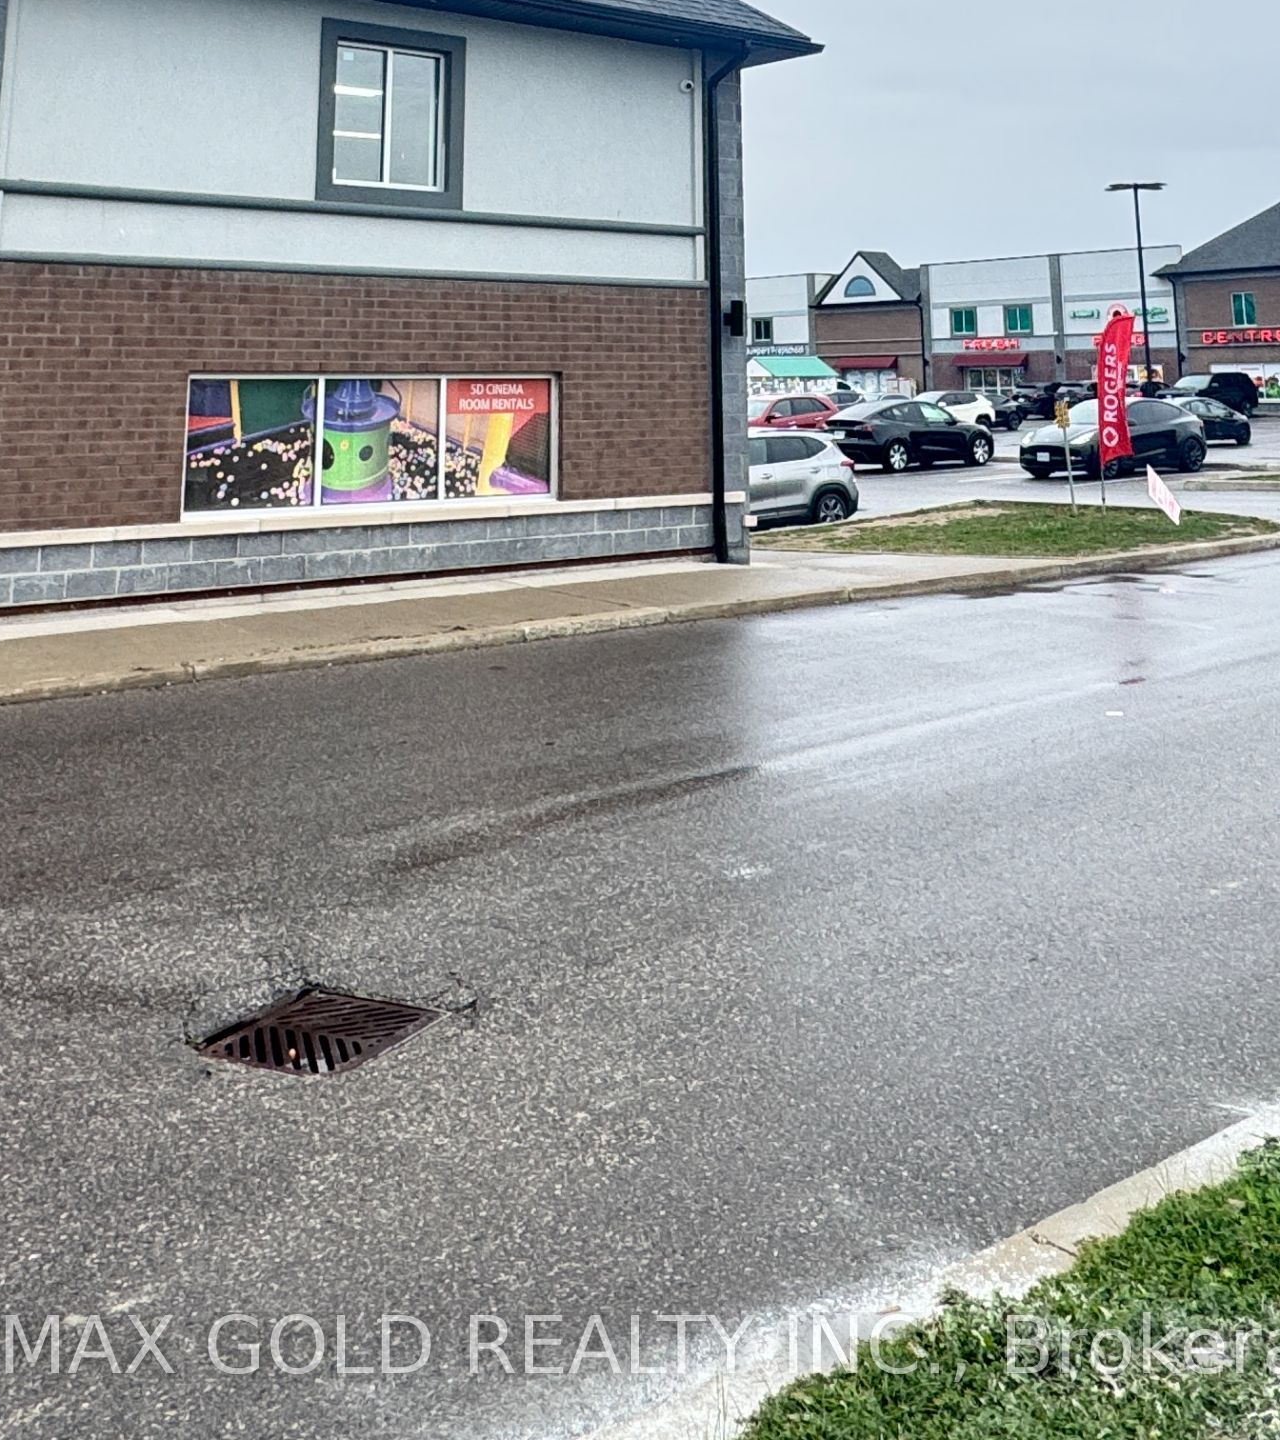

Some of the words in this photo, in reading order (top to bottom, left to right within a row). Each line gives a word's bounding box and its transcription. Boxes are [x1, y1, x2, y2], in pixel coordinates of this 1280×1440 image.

[1103, 342, 1119, 422] ROGERS
[486, 384, 524, 395] CINEMA
[459, 399, 490, 410] ROOM
[492, 398, 534, 410] RENTALS
